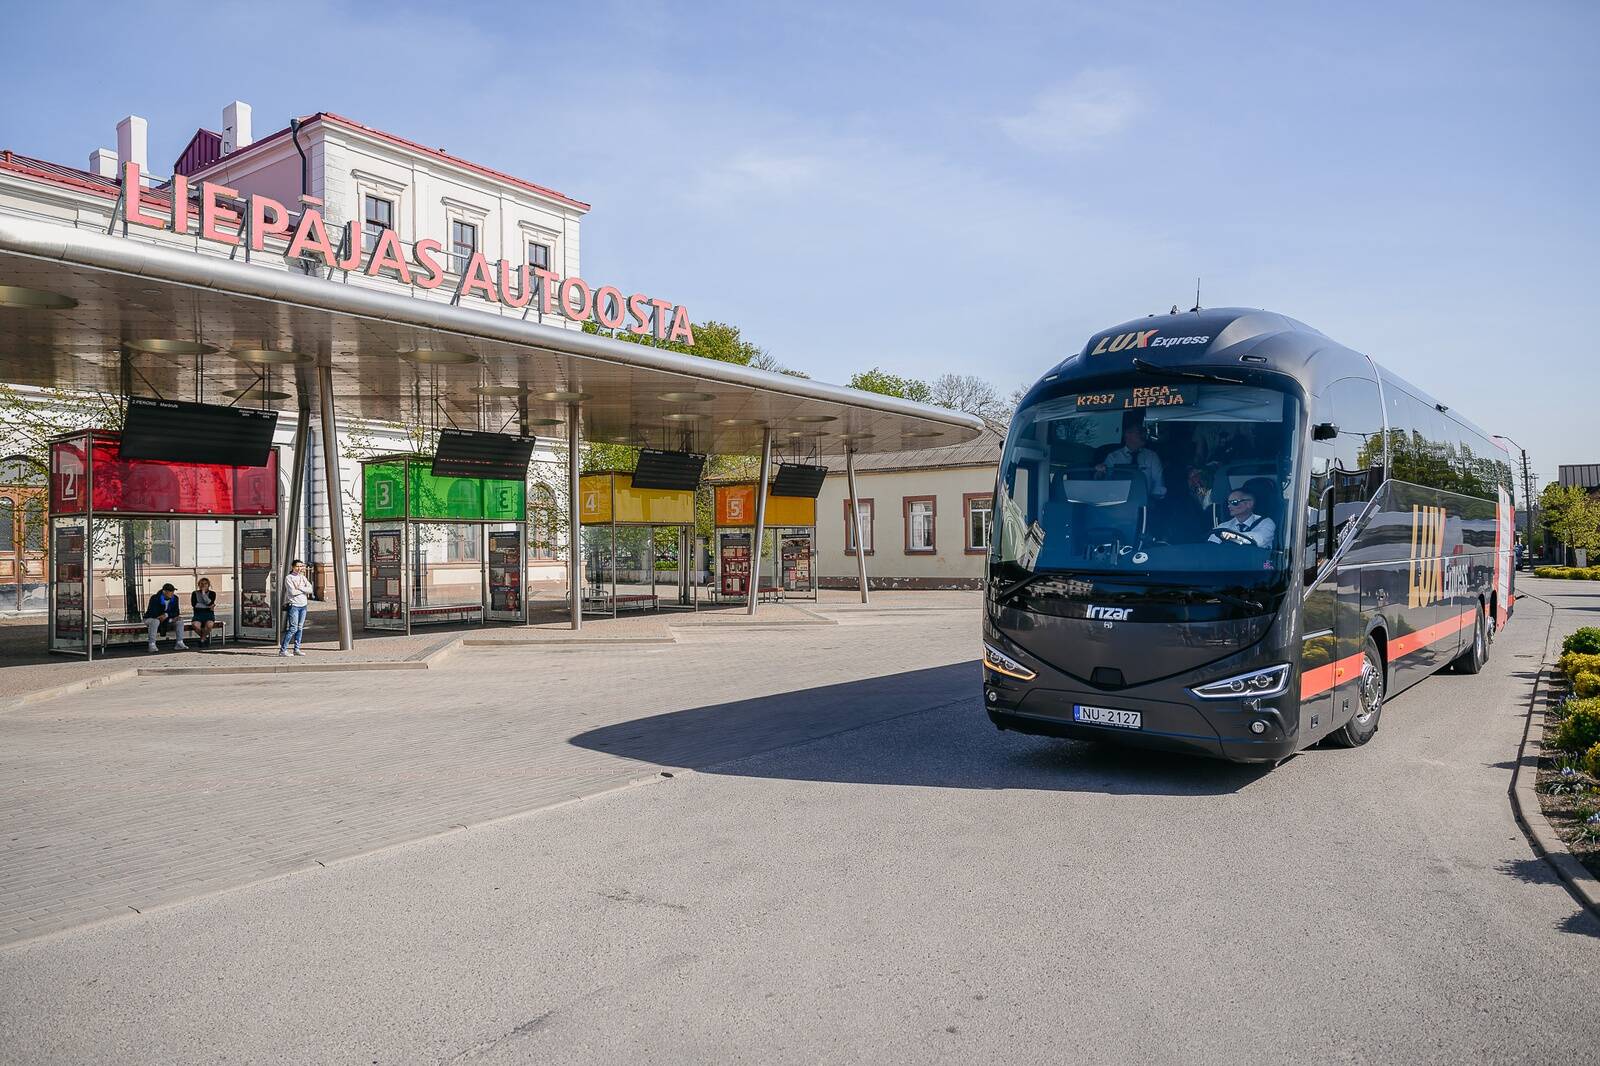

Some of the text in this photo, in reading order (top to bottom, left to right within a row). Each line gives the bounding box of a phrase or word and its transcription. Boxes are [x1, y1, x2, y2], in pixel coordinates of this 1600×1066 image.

[123, 161, 695, 346] LIEPĀJAS AUTOOSTA
[1091, 329, 1210, 356] LUX Express
[1077, 393, 1115, 406] K7937
[1124, 394, 1184, 408] LIEPĀJA
[65, 468, 74, 496] 2
[380, 483, 390, 506] 3
[585, 494, 597, 512] 4
[730, 500, 740, 517] 5
[1408, 504, 1446, 610] LUX
[1086, 604, 1133, 620] Irizar
[1082, 707, 1139, 725] NU-2127
